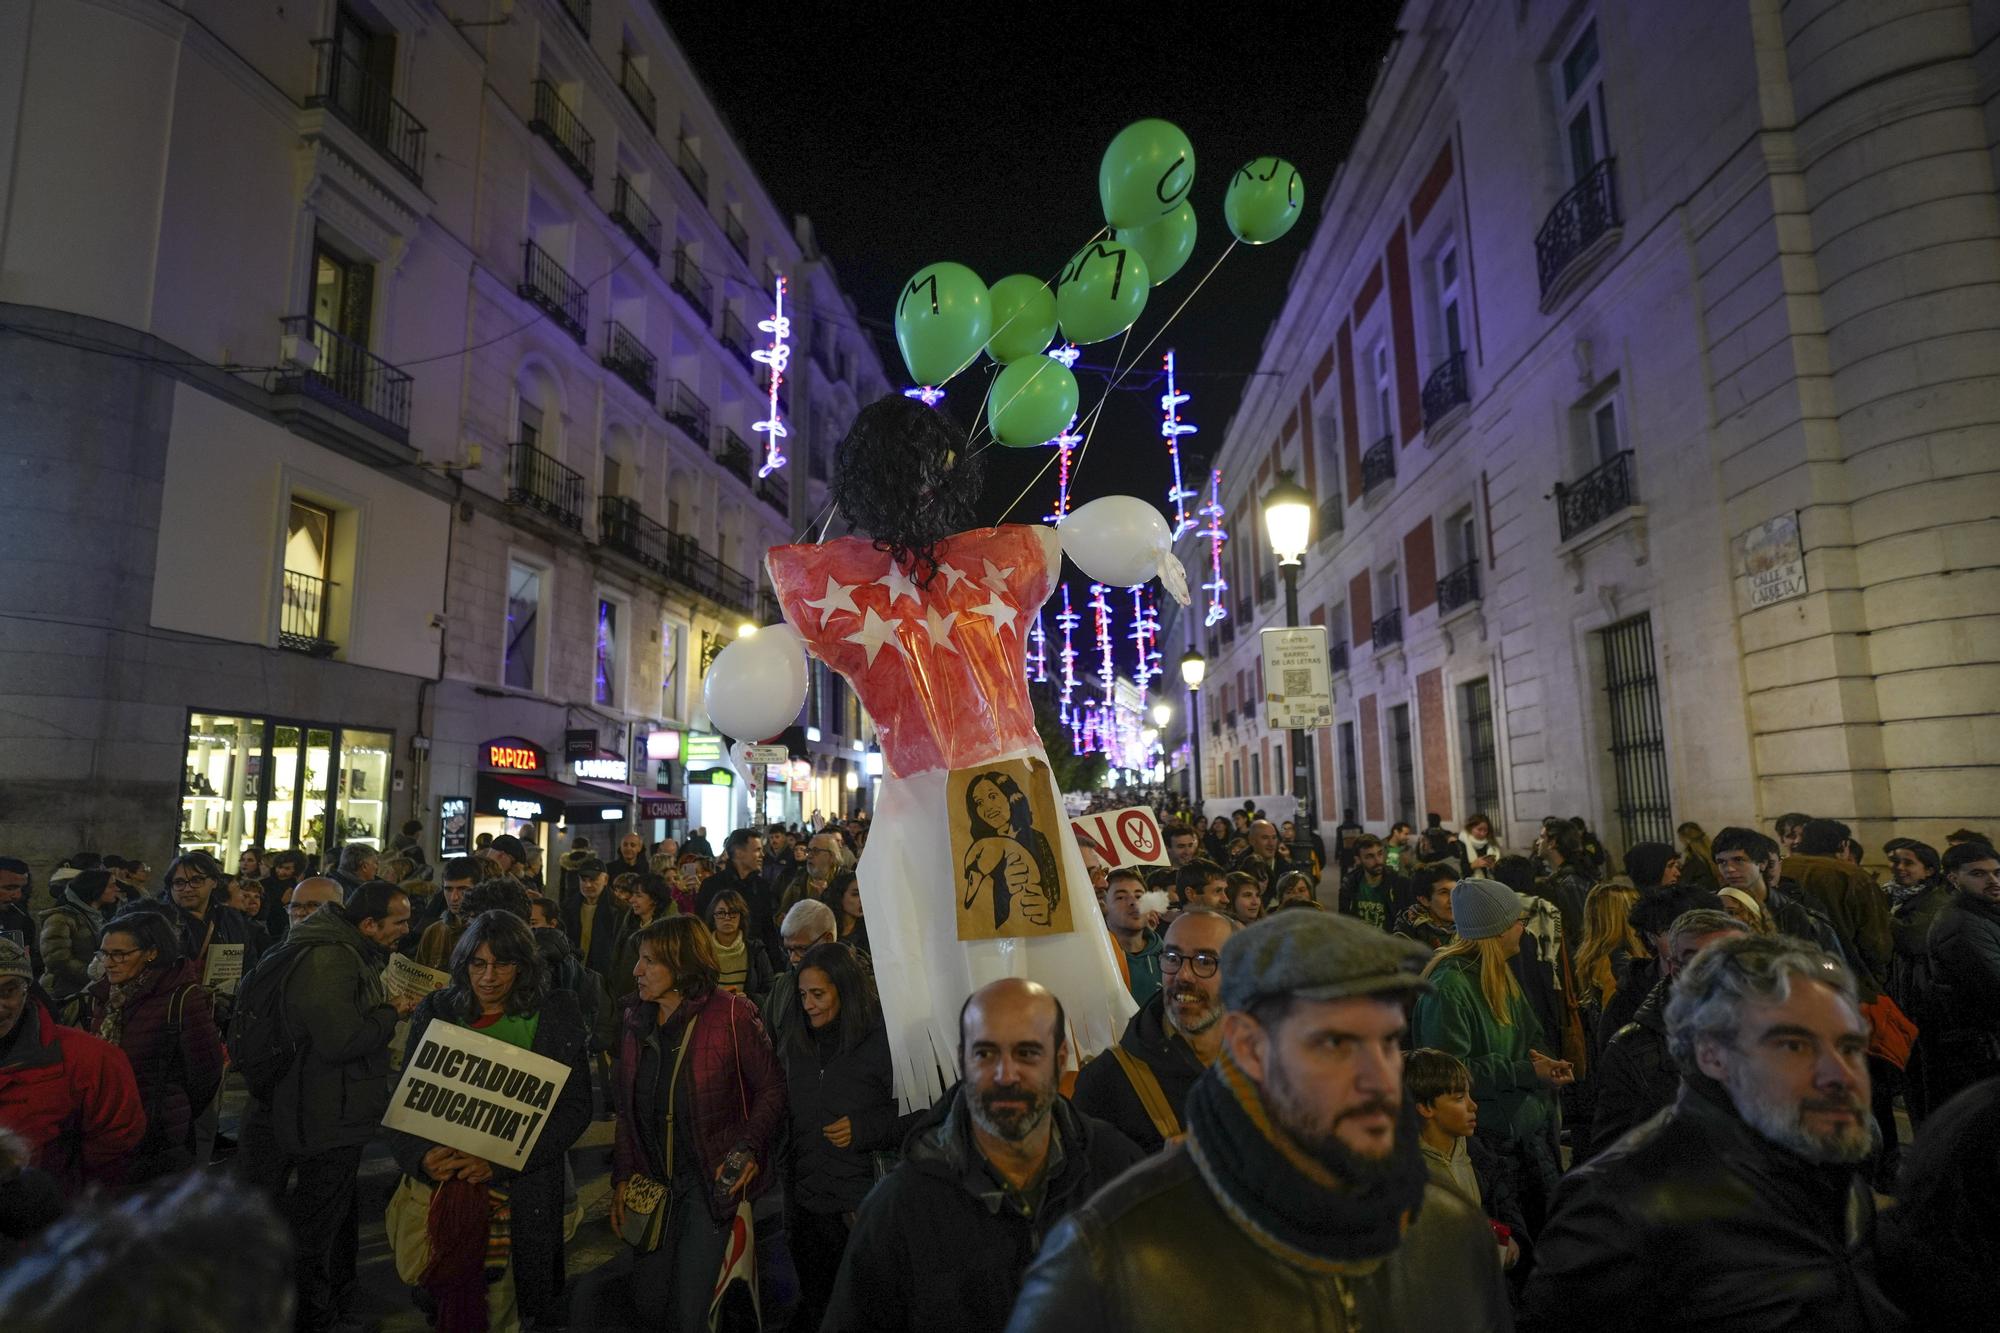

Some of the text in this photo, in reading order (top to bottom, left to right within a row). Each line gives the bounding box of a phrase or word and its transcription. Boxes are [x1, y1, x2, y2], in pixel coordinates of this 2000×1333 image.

[1296, 657, 1321, 665] LETRAS
[490, 746, 537, 770] PAPIZZA
[651, 803, 682, 816] CHANGE
[1070, 809, 1161, 870] NO
[414, 1039, 556, 1111] DICTADURA
